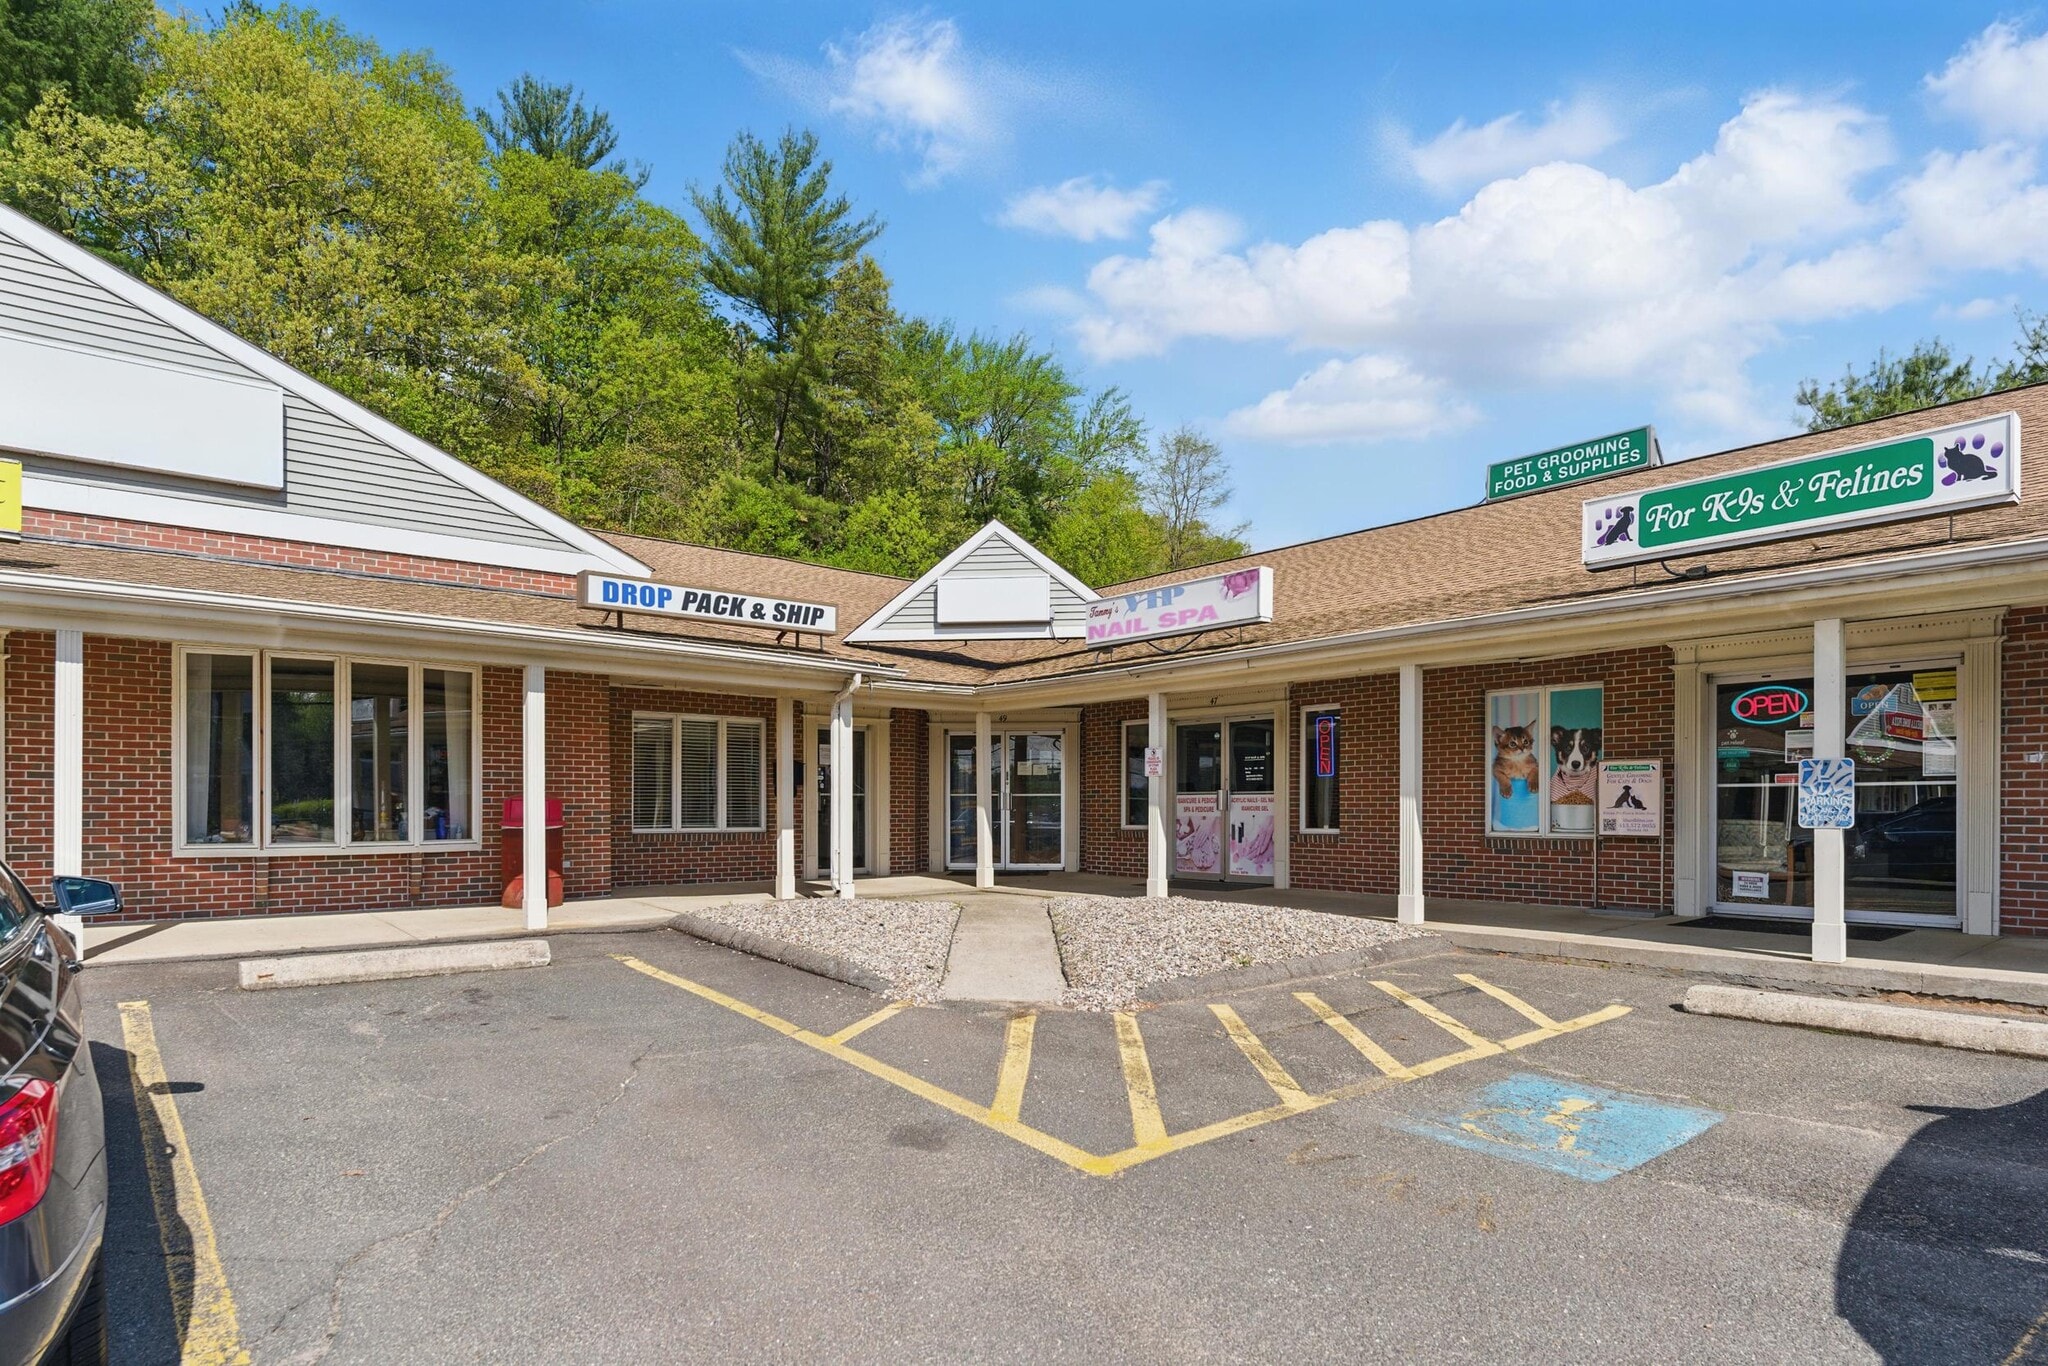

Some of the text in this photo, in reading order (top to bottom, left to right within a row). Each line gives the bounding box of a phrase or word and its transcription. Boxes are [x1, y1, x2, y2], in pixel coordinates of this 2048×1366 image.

[1495, 449, 1641, 493] FOOD & SUPPLIES
[1504, 436, 1630, 478] PET GROOMING
[1645, 462, 1924, 534] For K-9s & Felines
[602, 580, 825, 626] DROP PACK & SHIP
[1087, 605, 1220, 640] NAIL SPA
[1736, 692, 1799, 717] OPEN
[1319, 720, 1331, 774] OPEN
[1806, 795, 1851, 806] PARKING
